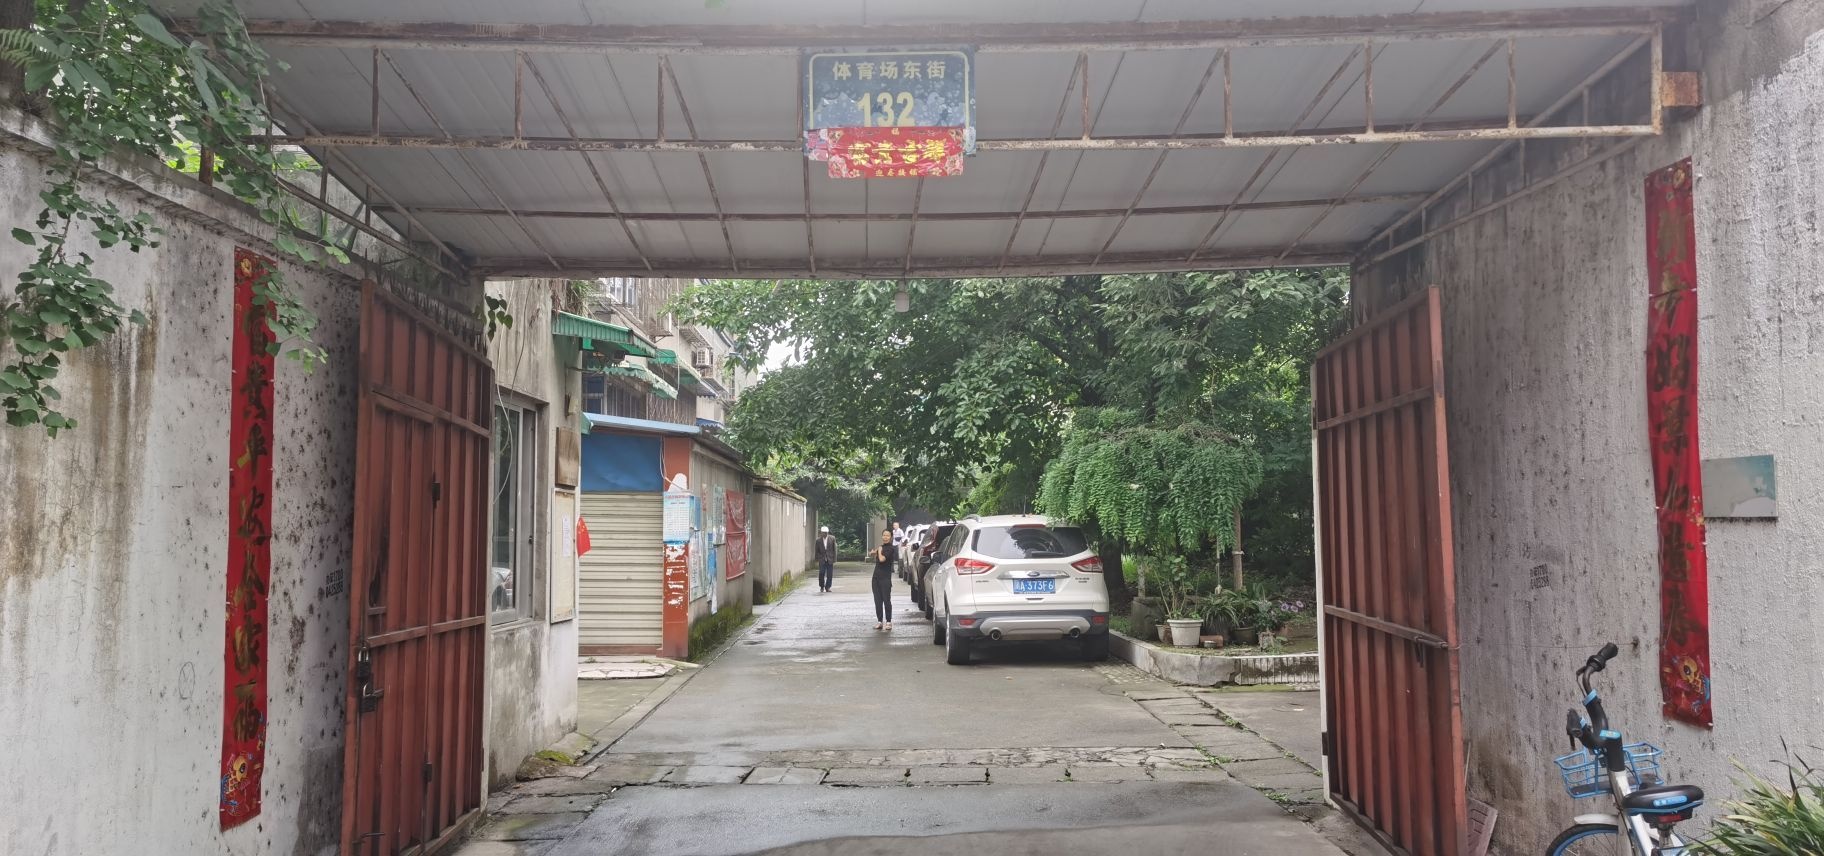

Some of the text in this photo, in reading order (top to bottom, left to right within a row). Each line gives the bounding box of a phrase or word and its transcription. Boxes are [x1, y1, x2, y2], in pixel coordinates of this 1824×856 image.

[833, 61, 946, 80] 体育场东街
[857, 91, 916, 127] 132
